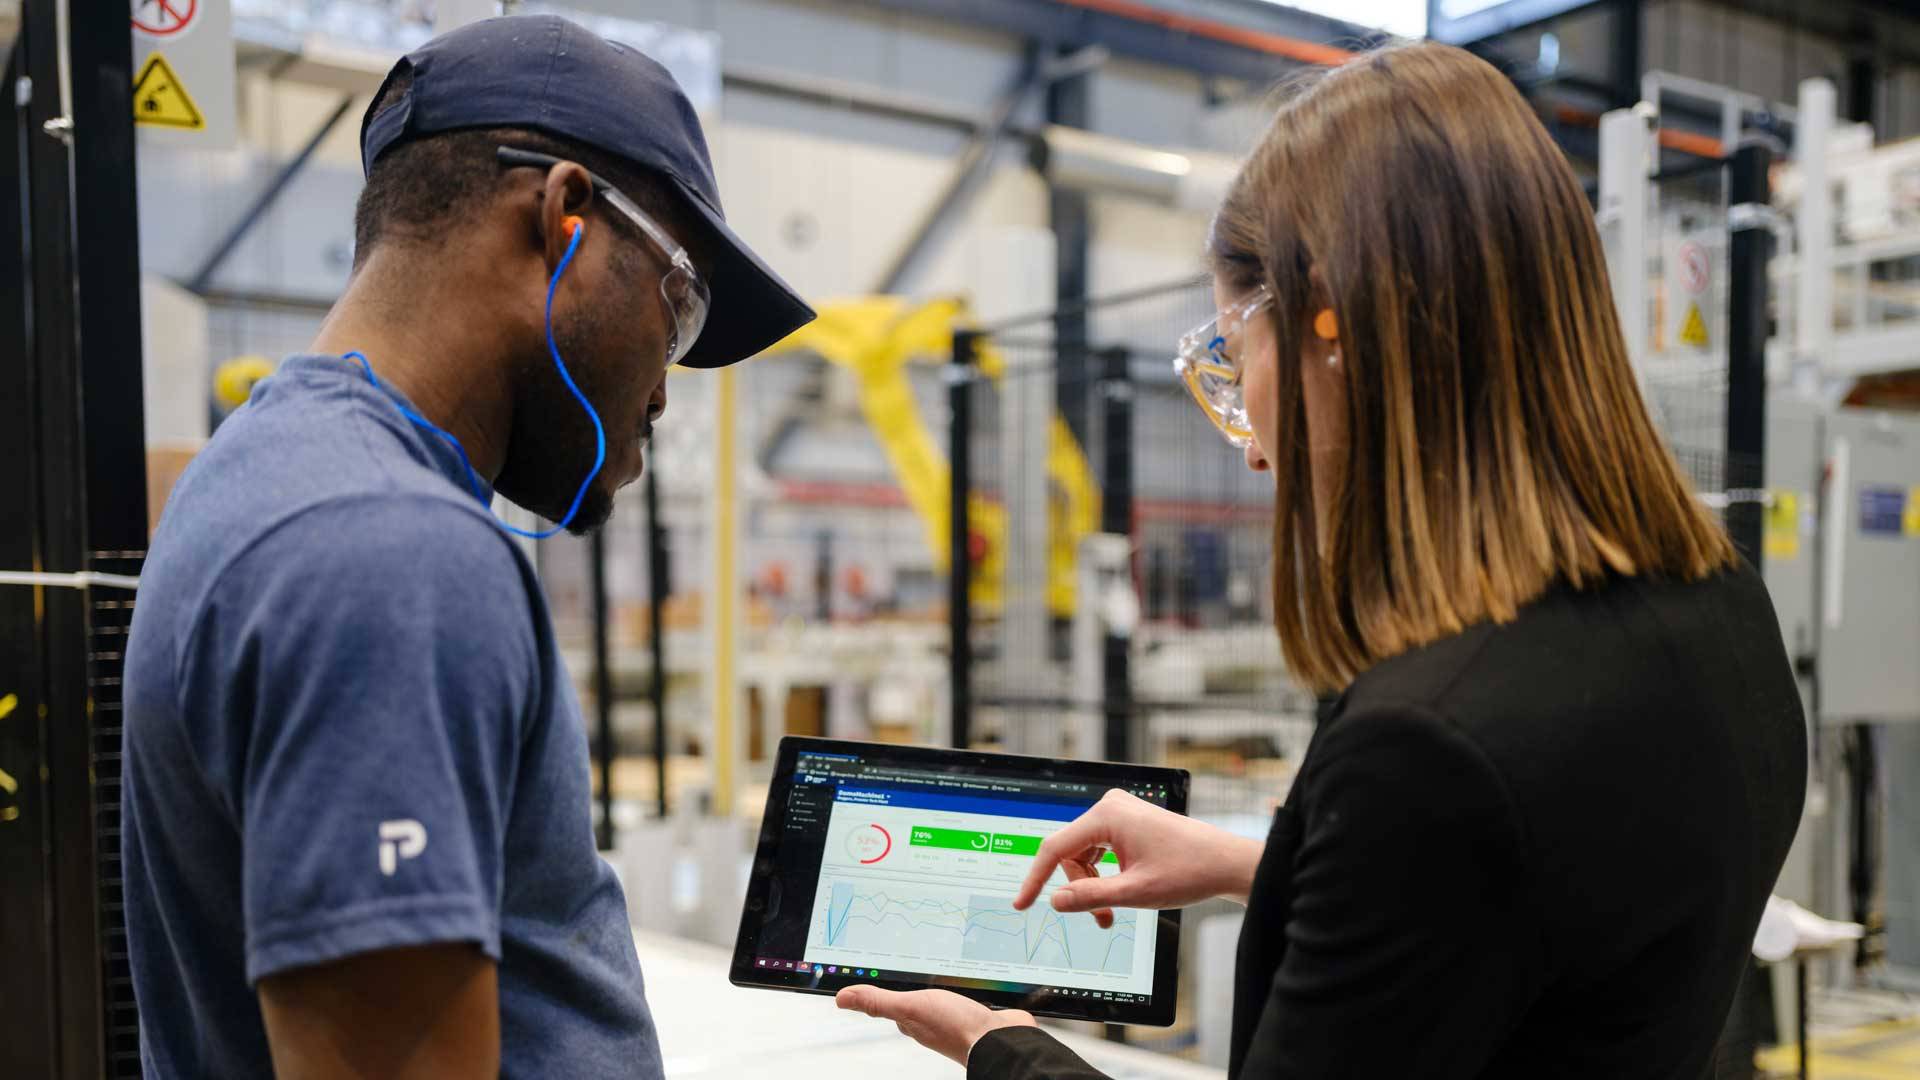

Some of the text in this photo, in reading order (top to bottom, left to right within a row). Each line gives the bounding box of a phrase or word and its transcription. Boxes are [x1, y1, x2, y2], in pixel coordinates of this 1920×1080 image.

[914, 831, 932, 840] 76%
[994, 838, 1013, 847] 81%
[379, 819, 427, 876] P
